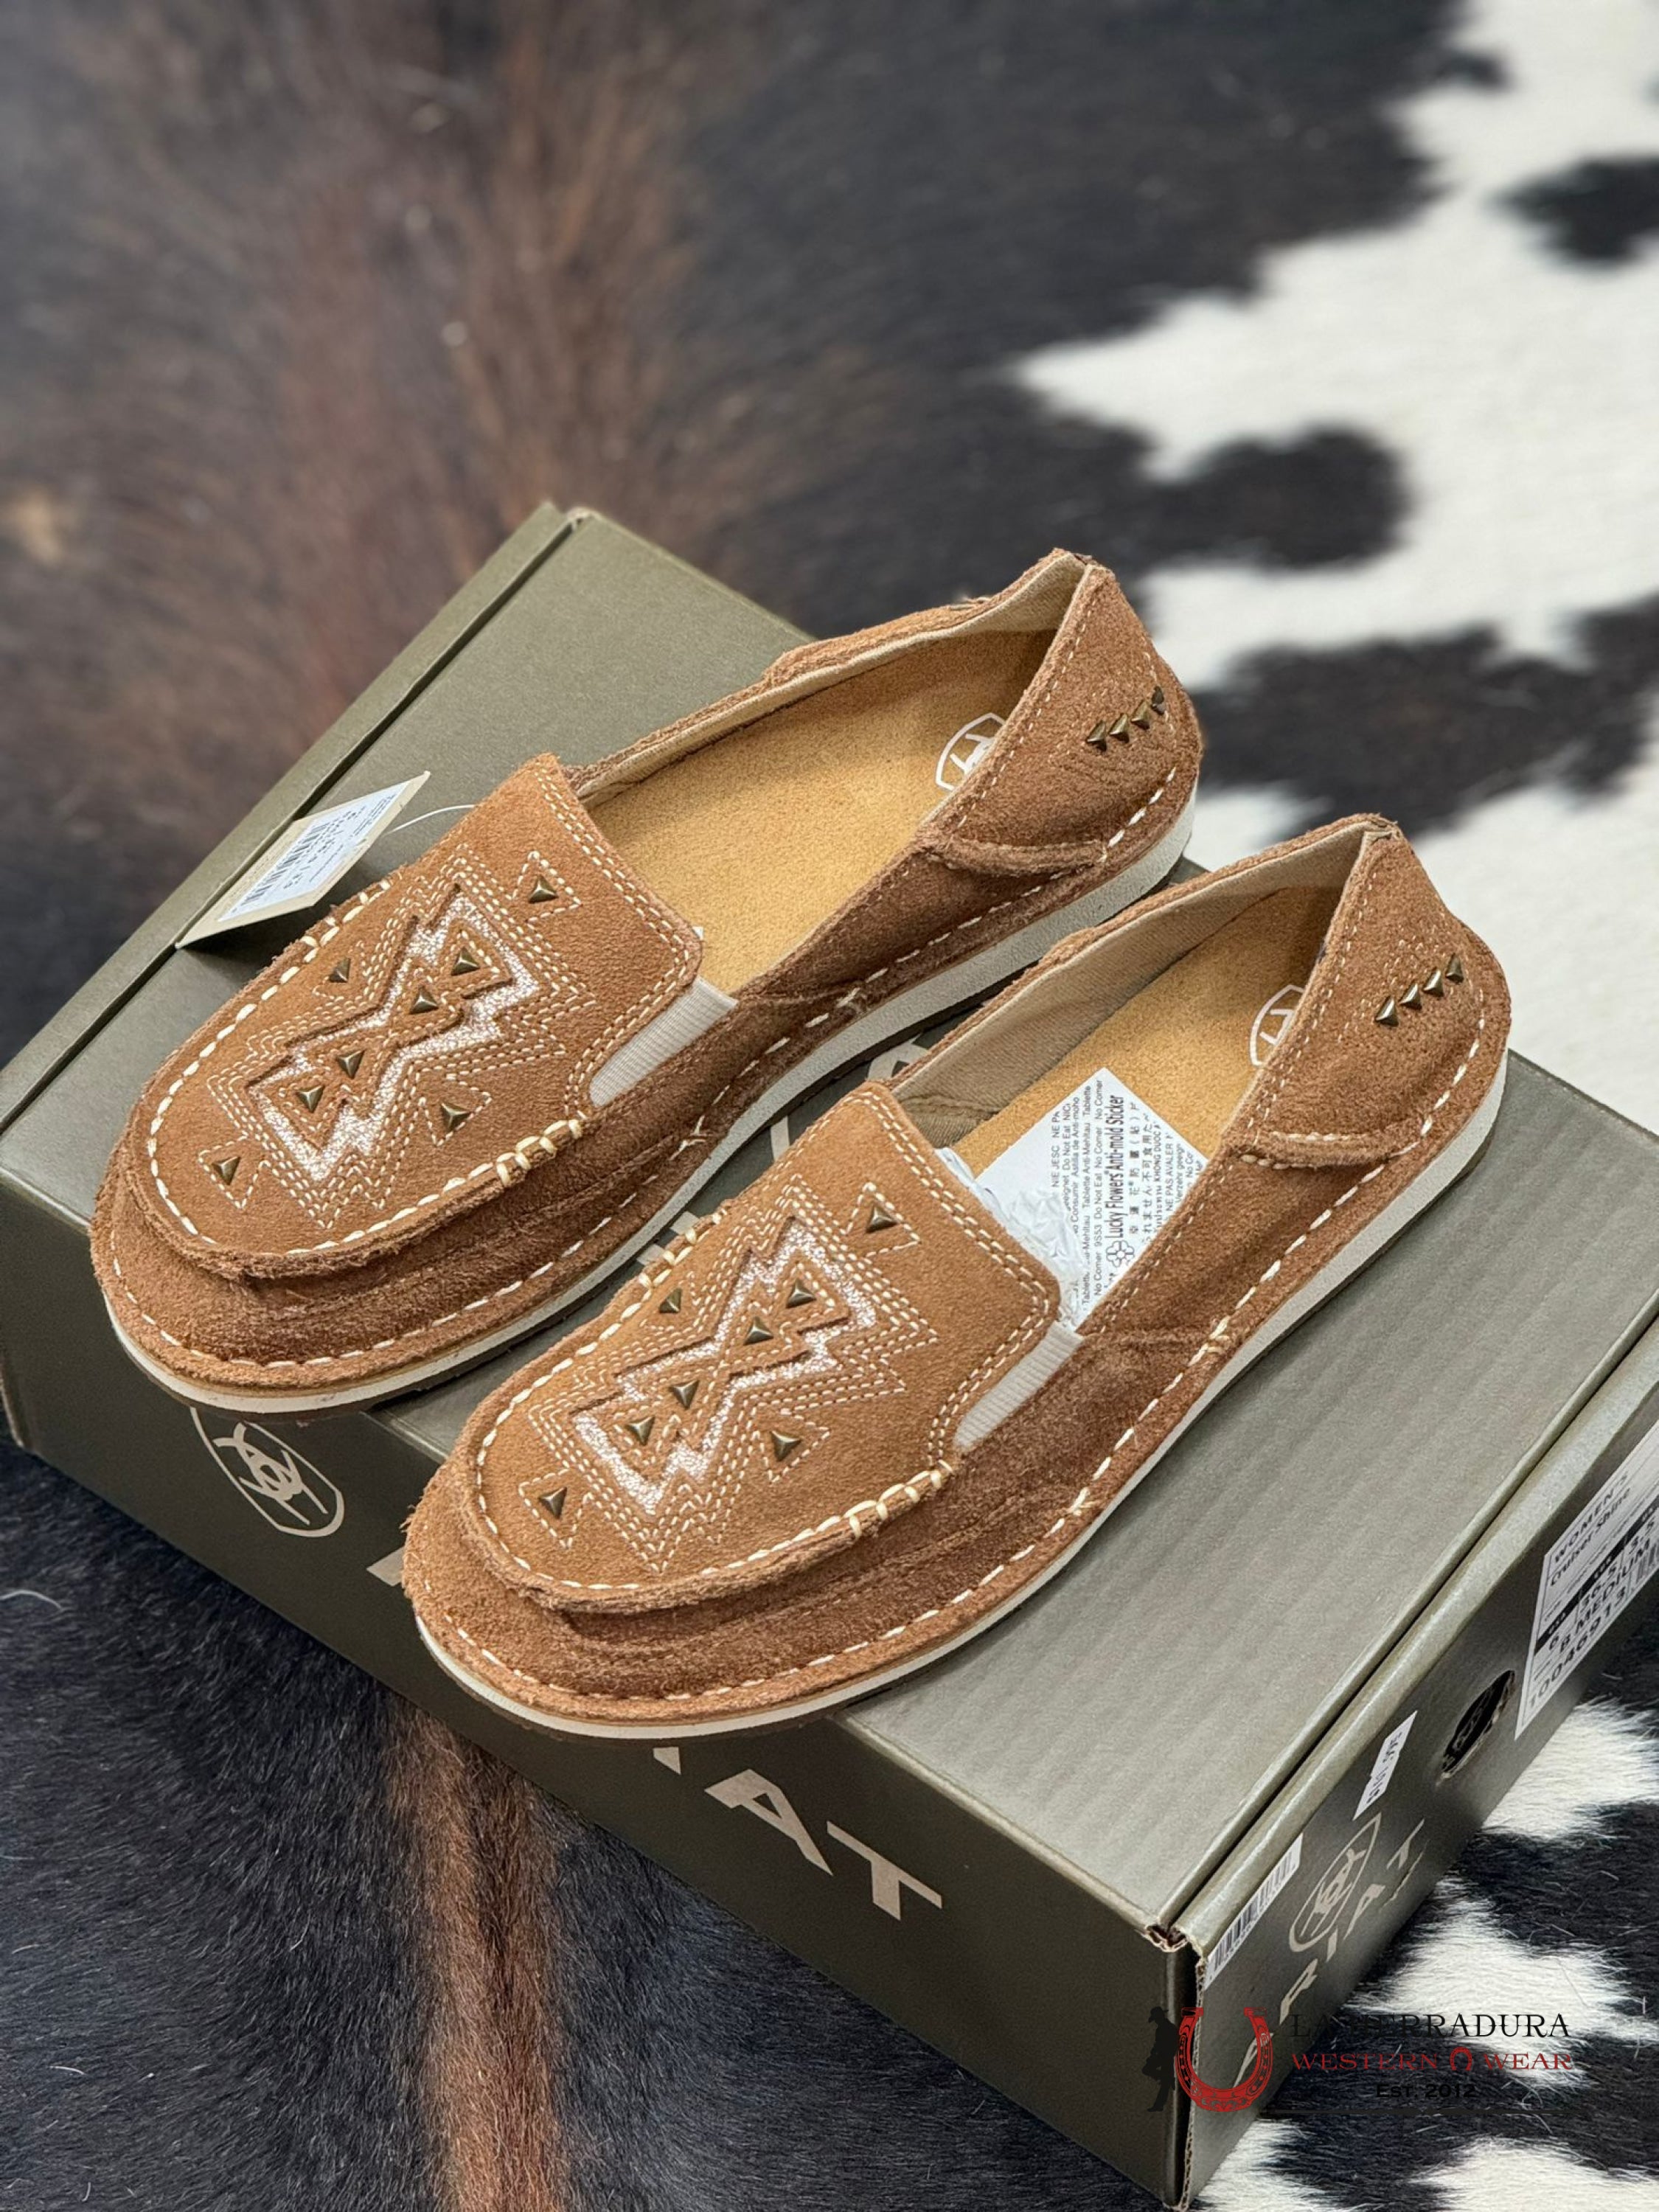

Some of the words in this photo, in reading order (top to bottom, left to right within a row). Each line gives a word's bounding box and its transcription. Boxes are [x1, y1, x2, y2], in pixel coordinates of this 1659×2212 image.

[1082, 1085, 1091, 1115] Tablette
[1094, 1079, 1102, 1106] Comer
[1094, 1107, 1102, 1119] No
[1105, 1095, 1124, 1124] Sticker
[1051, 1125, 1060, 1138] NE
[1062, 1126, 1071, 1138] Eat
[1094, 1127, 1102, 1154] Comer
[1062, 1142, 1071, 1156] Not
[1072, 1140, 1079, 1150] de
[1105, 1127, 1124, 1171] Anti-mold
[1063, 1159, 1071, 1170] Do
[1094, 1157, 1102, 1168] No
[1165, 1143, 1174, 1177] AVALER
[1051, 1172, 1060, 1187] NIE
[1094, 1173, 1102, 1187] Eat
[1165, 1178, 1174, 1196] PAS
[1082, 1176, 1091, 1208] Tablette
[1094, 1190, 1102, 1205] Not
[1071, 1181, 1079, 1222] Consumir
[1165, 1199, 1174, 1211] NE
[1094, 1208, 1102, 1218] Do
[1104, 1211, 1128, 1239] Lucky
[1094, 1252, 1102, 1281] Comer
[1094, 1284, 1102, 1295] No
[1550, 1533, 1592, 1587] Cruiser
[1596, 1487, 1631, 1529] Shine
[1576, 1542, 1650, 1635] MEDIUM
[1530, 1586, 1627, 1709] 10046913
